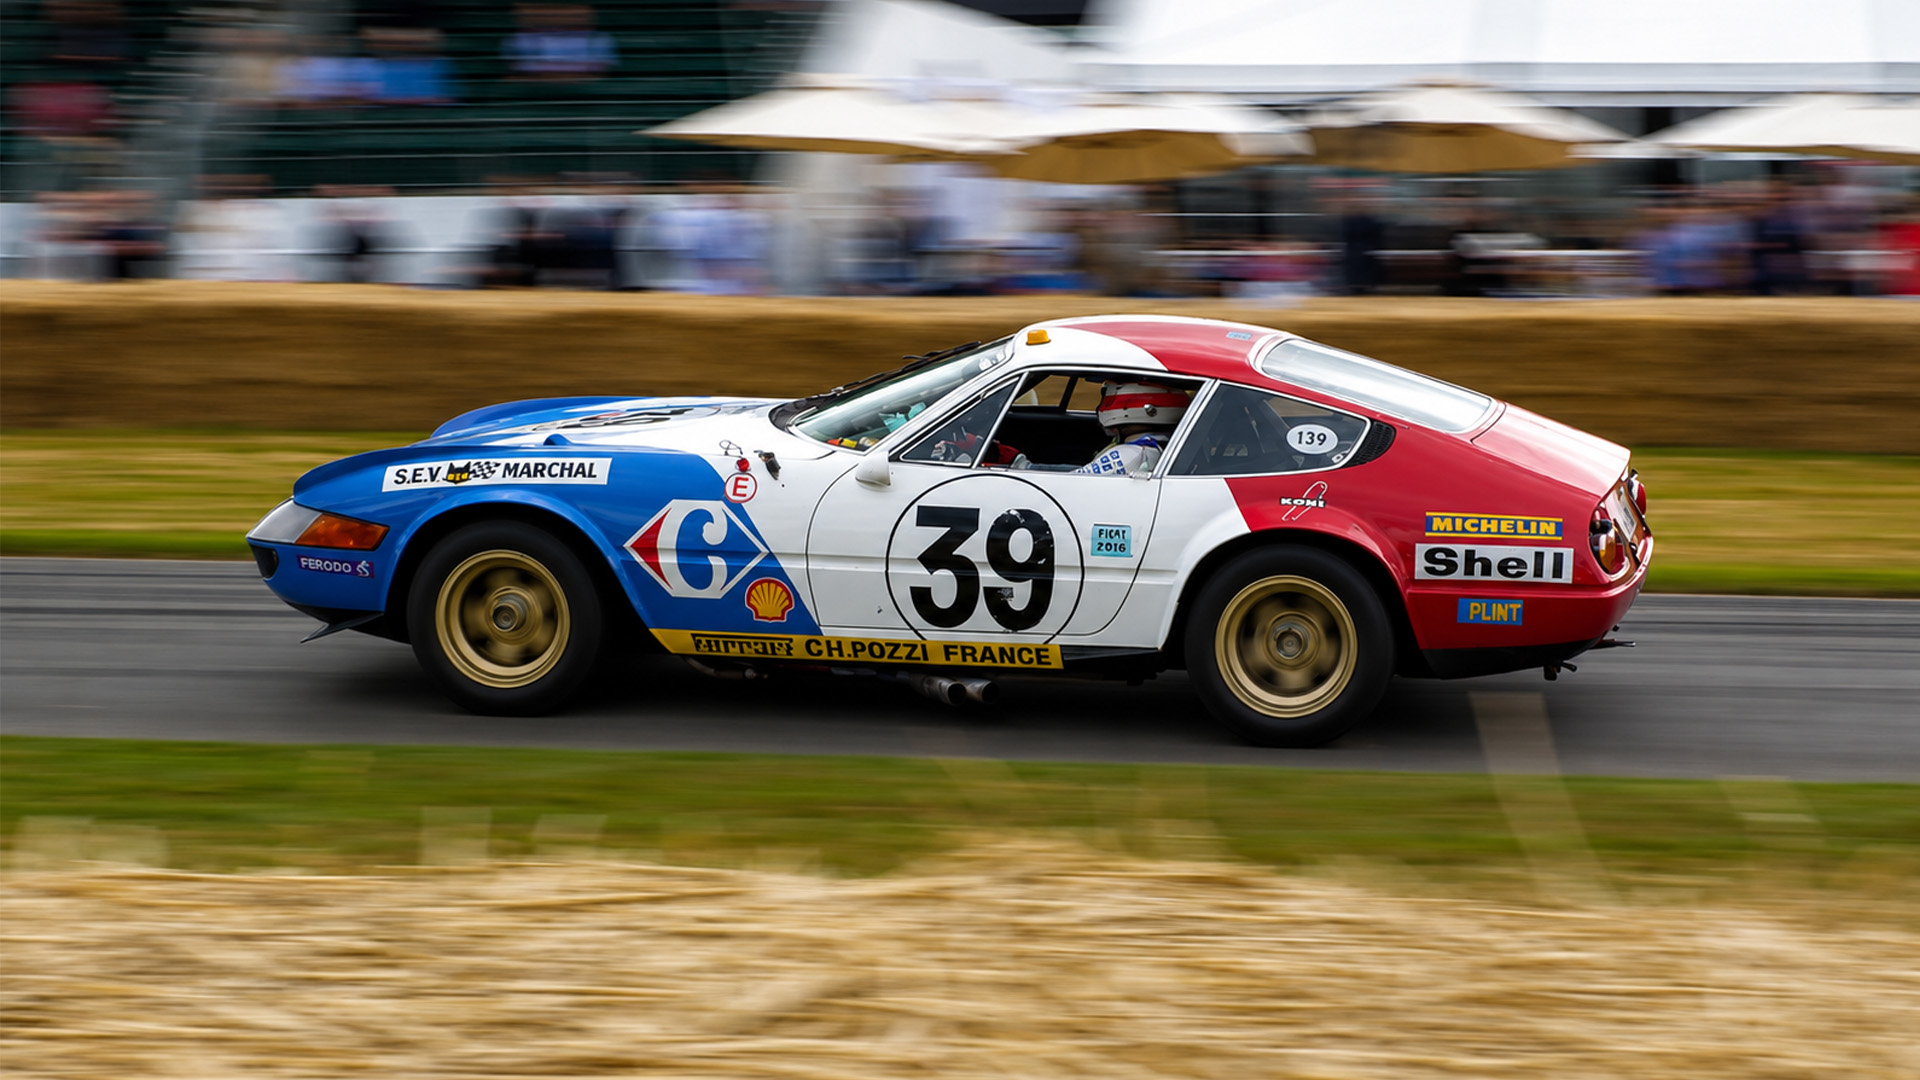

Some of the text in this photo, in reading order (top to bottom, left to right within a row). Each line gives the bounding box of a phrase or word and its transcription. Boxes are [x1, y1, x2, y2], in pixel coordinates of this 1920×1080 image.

[1297, 431, 1327, 446] 139
[502, 462, 598, 478] MARCHAL
[732, 477, 749, 497] E
[1280, 498, 1325, 508] KONI
[1432, 517, 1556, 535] MICHELIN
[1097, 542, 1126, 553] 2016
[300, 557, 352, 573] FERODO
[909, 505, 1055, 631] 39
[1424, 547, 1564, 579] Shell
[1469, 602, 1521, 622] PLINT
[804, 638, 929, 662] CH.POZZI
[943, 644, 1052, 666] FRANCE
